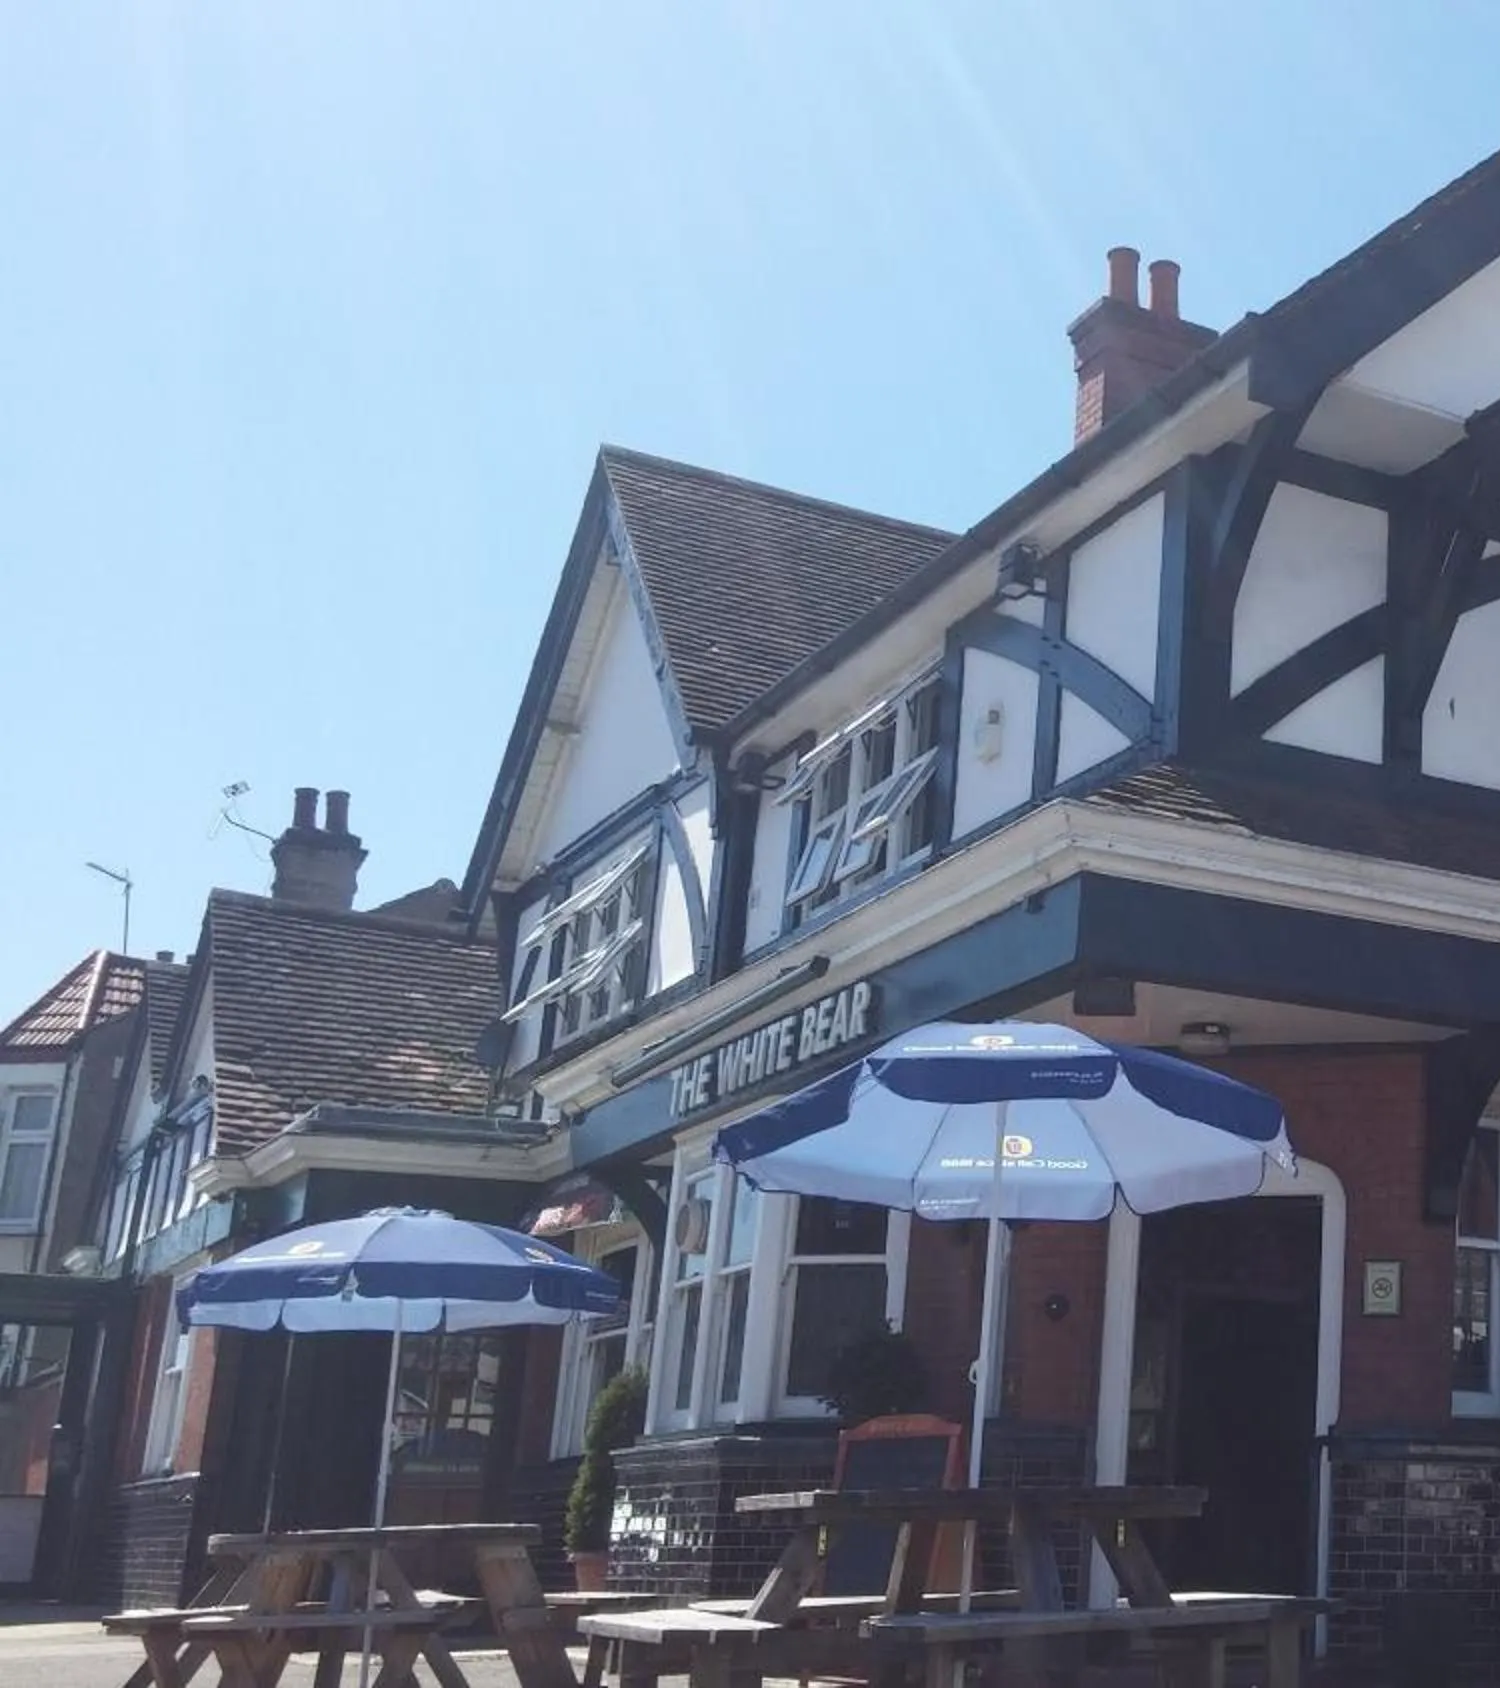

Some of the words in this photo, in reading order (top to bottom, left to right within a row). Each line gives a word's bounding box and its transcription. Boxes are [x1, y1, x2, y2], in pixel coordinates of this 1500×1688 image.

[669, 1054, 711, 1118] THE
[717, 1015, 796, 1096] WHITE
[798, 982, 872, 1061] BEAR
